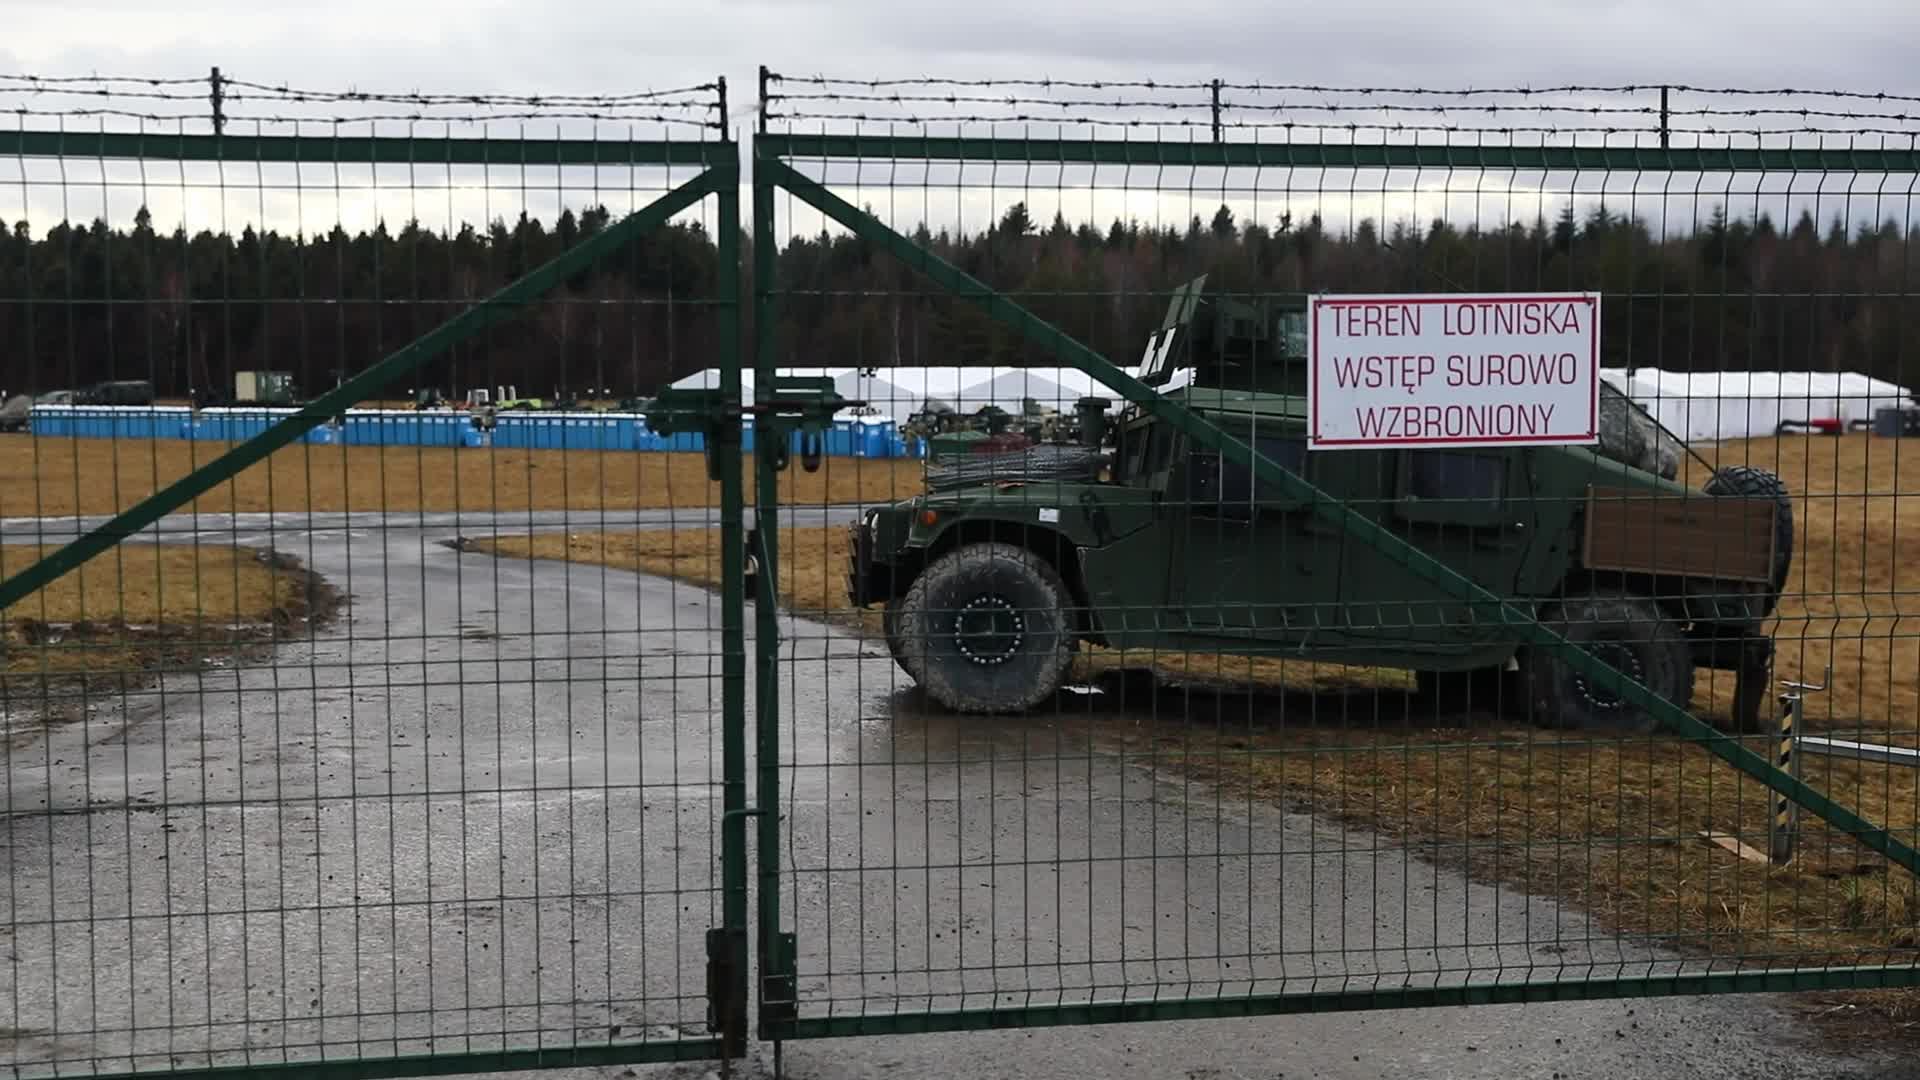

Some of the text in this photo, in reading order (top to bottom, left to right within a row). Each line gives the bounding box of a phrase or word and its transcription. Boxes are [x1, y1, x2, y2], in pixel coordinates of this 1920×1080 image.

[1331, 303, 1580, 336] TEREN LOTNISKA
[1333, 353, 1577, 394] WSTĘP SUROWO
[1356, 404, 1555, 438] WZBRONIONY
